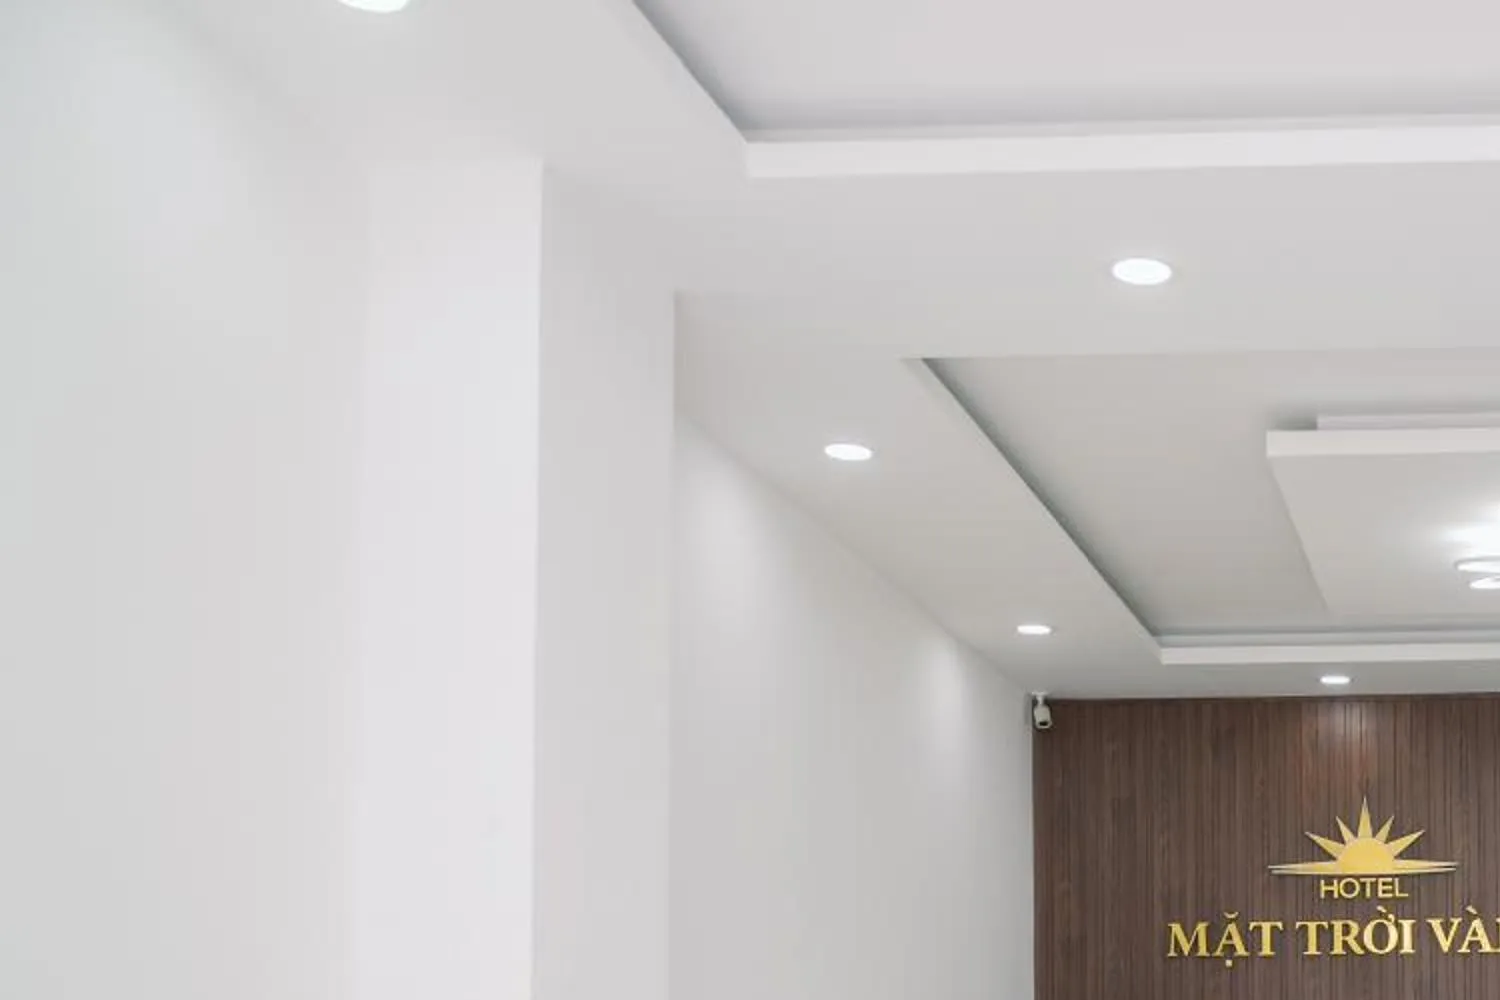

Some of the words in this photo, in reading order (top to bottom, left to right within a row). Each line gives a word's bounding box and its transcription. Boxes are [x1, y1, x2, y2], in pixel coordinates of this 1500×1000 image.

[1319, 877, 1409, 900] HOTEL
[1167, 910, 1284, 968] MẶT
[1295, 905, 1418, 957] TRỜI
